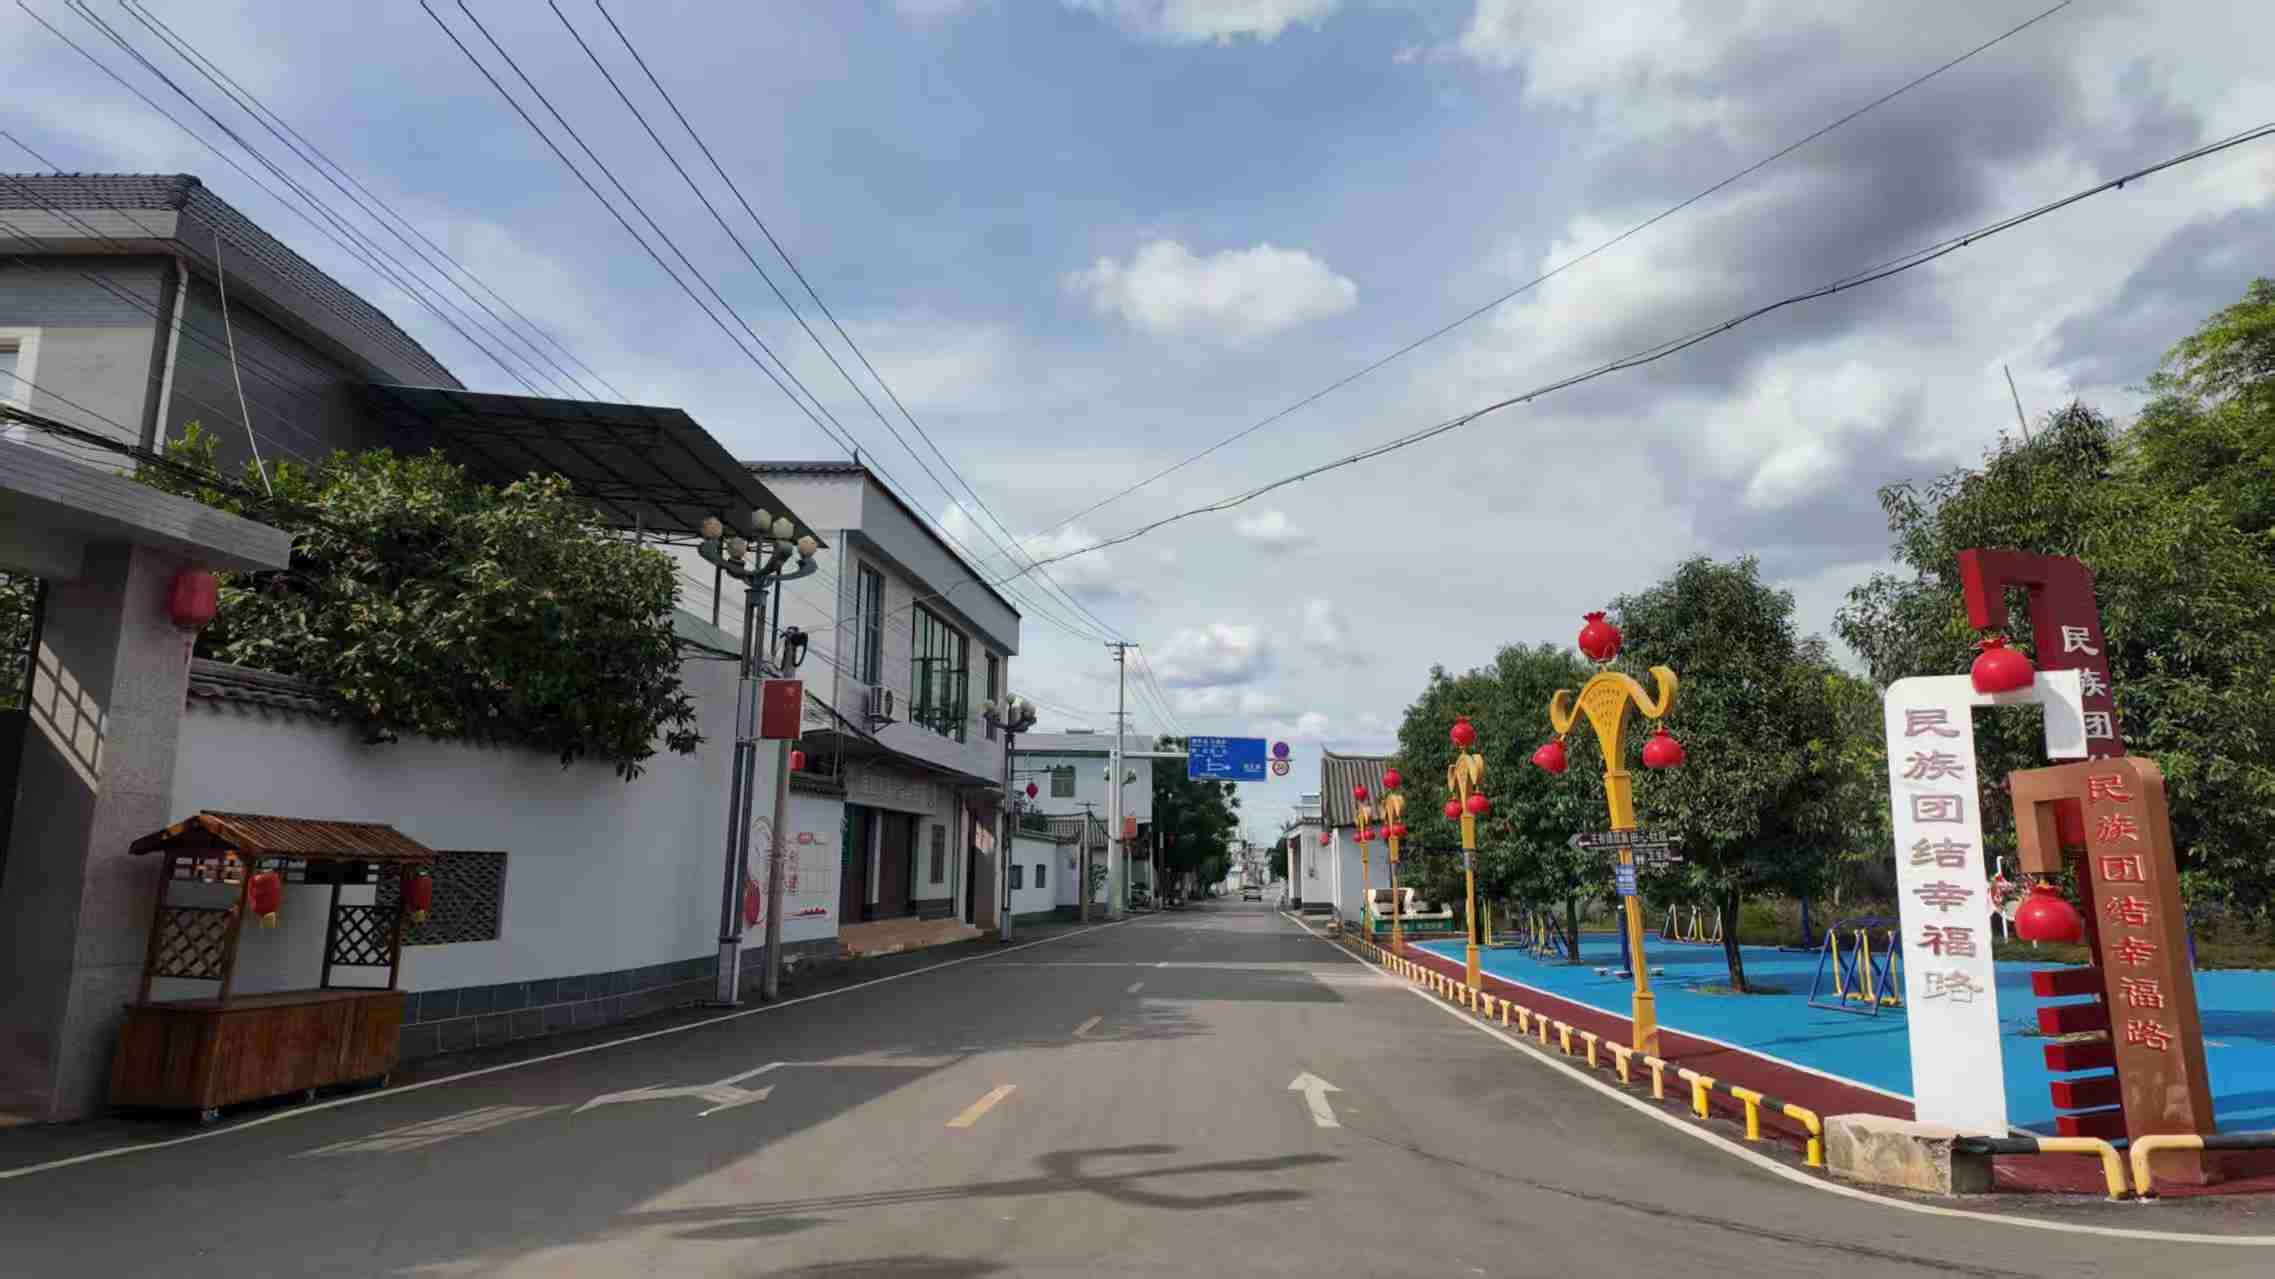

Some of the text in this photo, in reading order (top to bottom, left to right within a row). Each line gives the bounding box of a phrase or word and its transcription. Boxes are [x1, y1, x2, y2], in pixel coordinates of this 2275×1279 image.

[2061, 625, 2114, 761] 民族团
[1903, 708, 1984, 1004] 民族团结幸福路
[2087, 774, 2174, 1051] 民族团结幸福路
